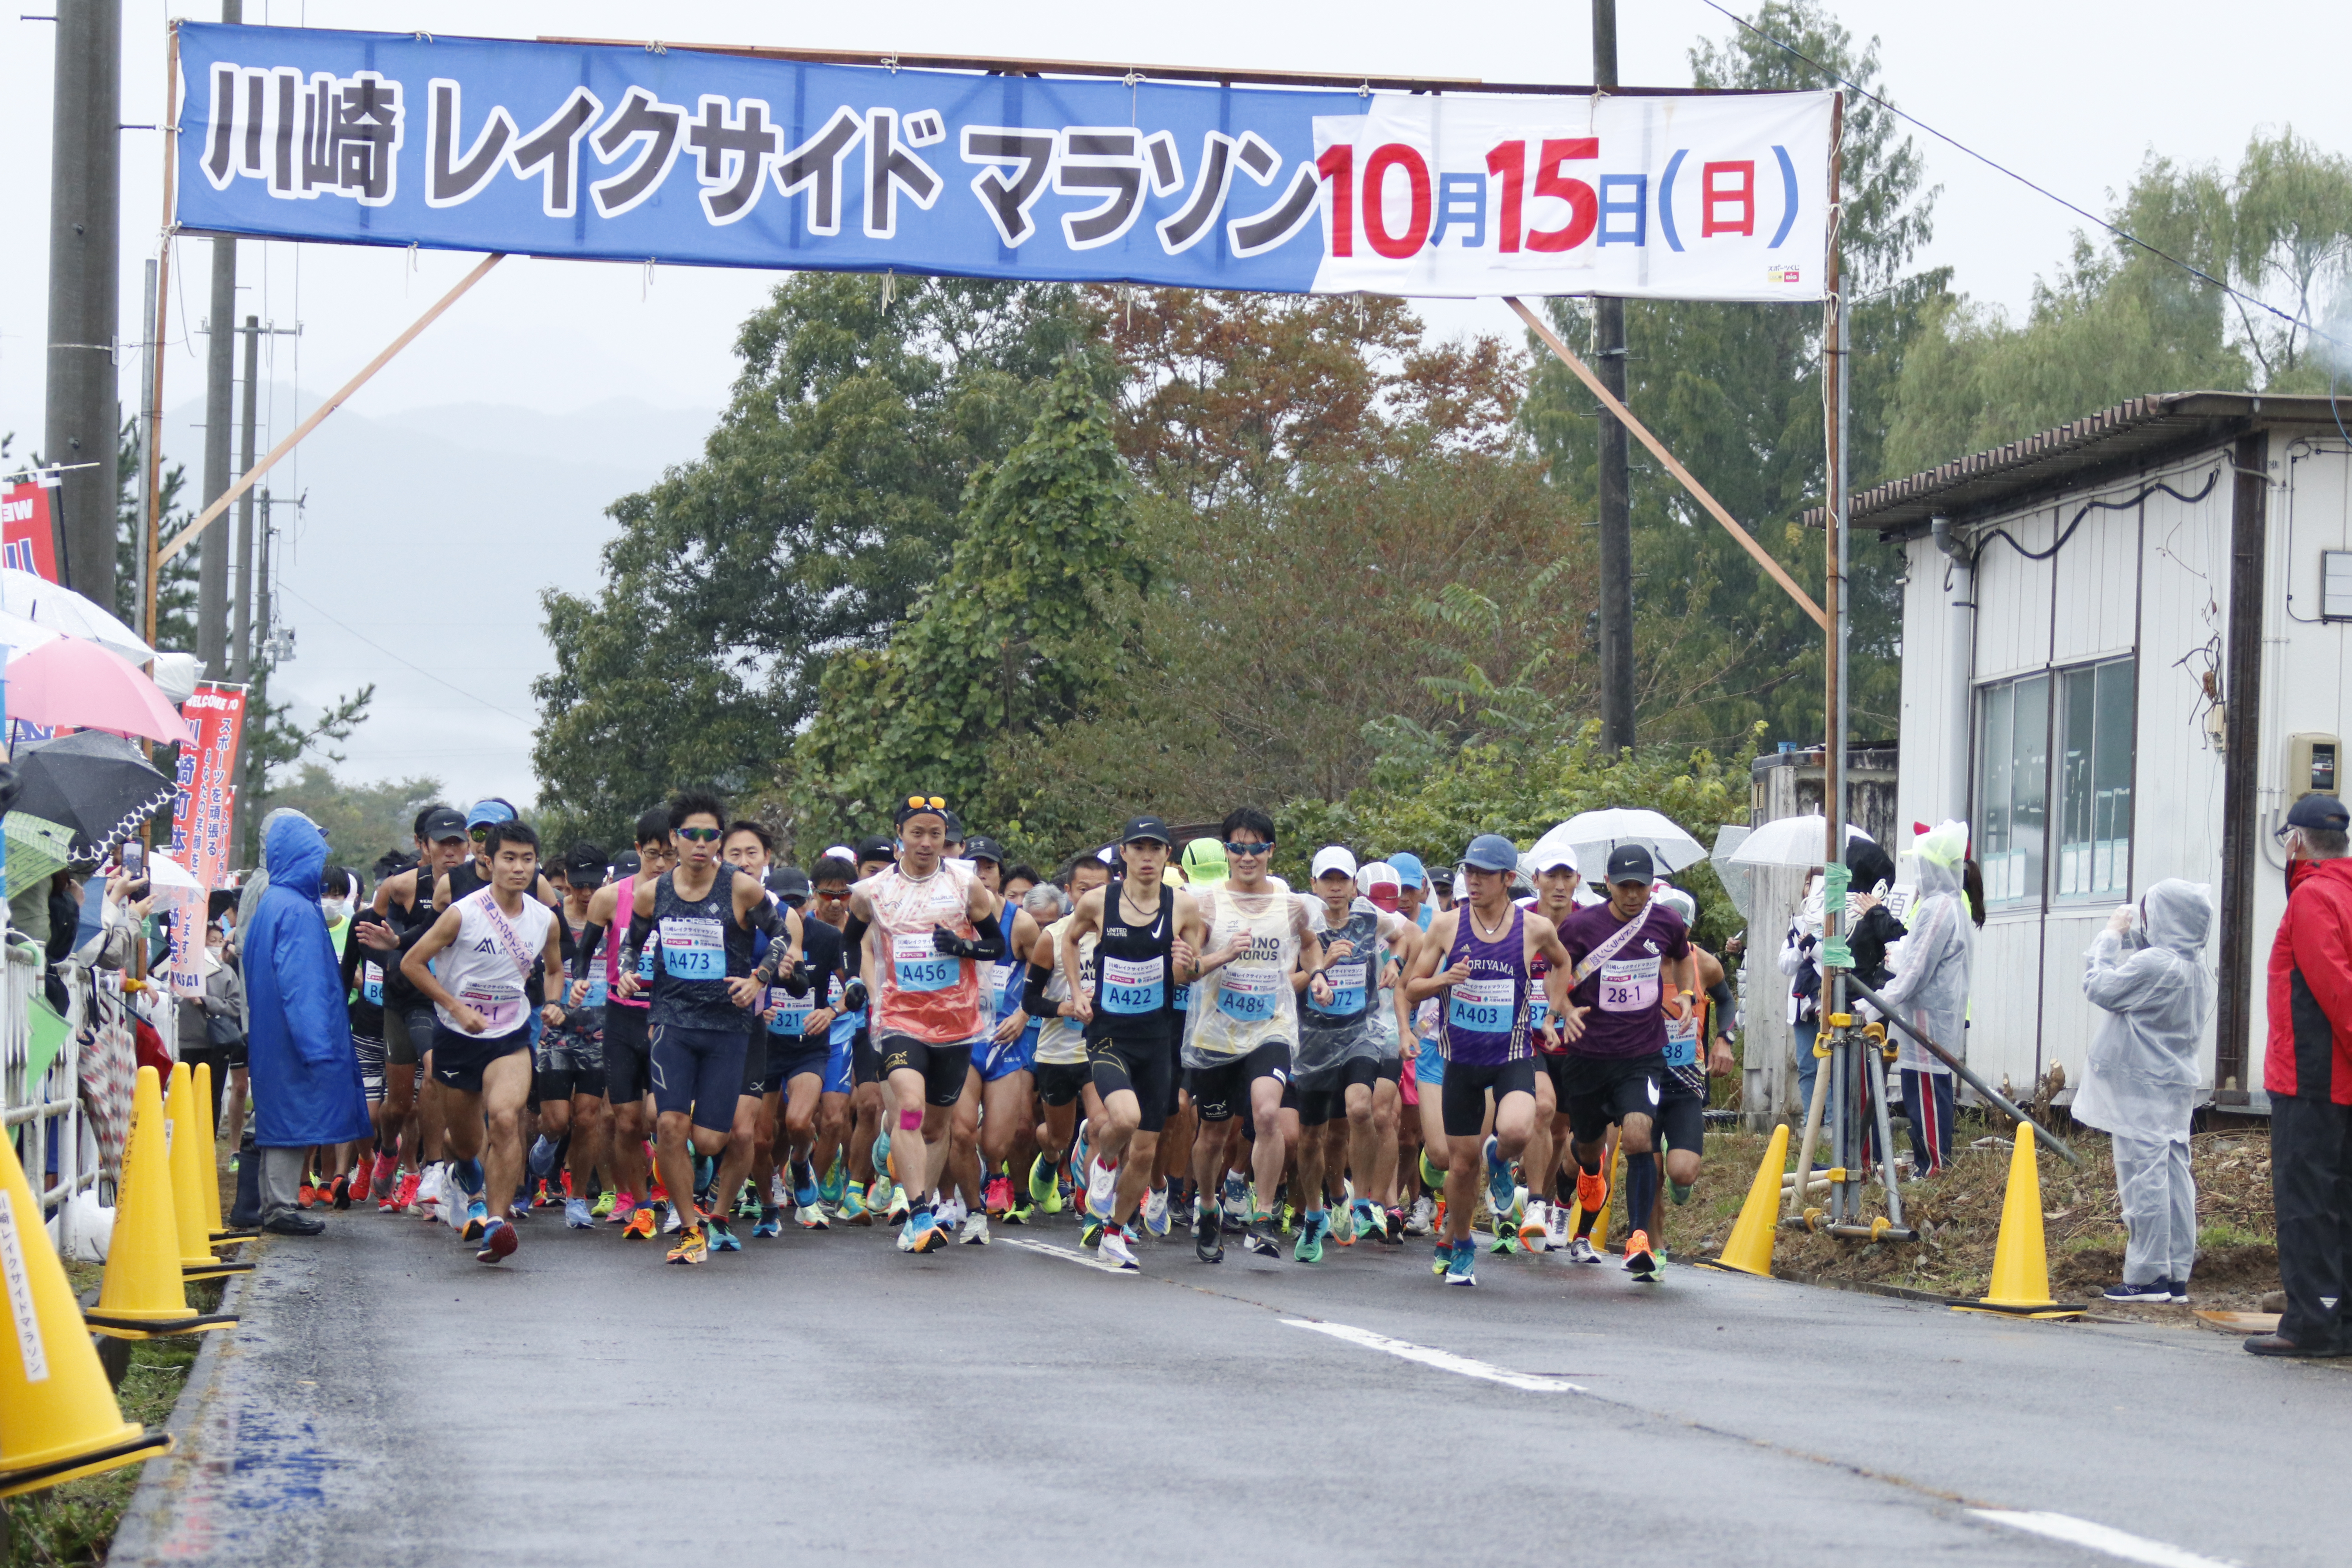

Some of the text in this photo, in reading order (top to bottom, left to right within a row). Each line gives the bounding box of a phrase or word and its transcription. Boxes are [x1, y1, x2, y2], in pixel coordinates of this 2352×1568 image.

[186, 695, 227, 710] WELCOME
[206, 718, 232, 856] スポーツを頑張る
[664, 926, 718, 935] 川崎レイクサイドマラソン
[670, 952, 709, 969] A473
[1109, 962, 1160, 971] 川崎レイクサイドマラソン
[1467, 960, 1514, 976] ORIYAMA
[1590, 955, 1600, 966] 2023
[902, 964, 946, 981] A456
[1109, 987, 1151, 1005] A422
[1223, 993, 1265, 1012] A489
[1608, 985, 1640, 1003] 28-1
[1456, 1004, 1497, 1024] A403
[116, 1111, 138, 1224] 川崎レイクサイドマラソン
